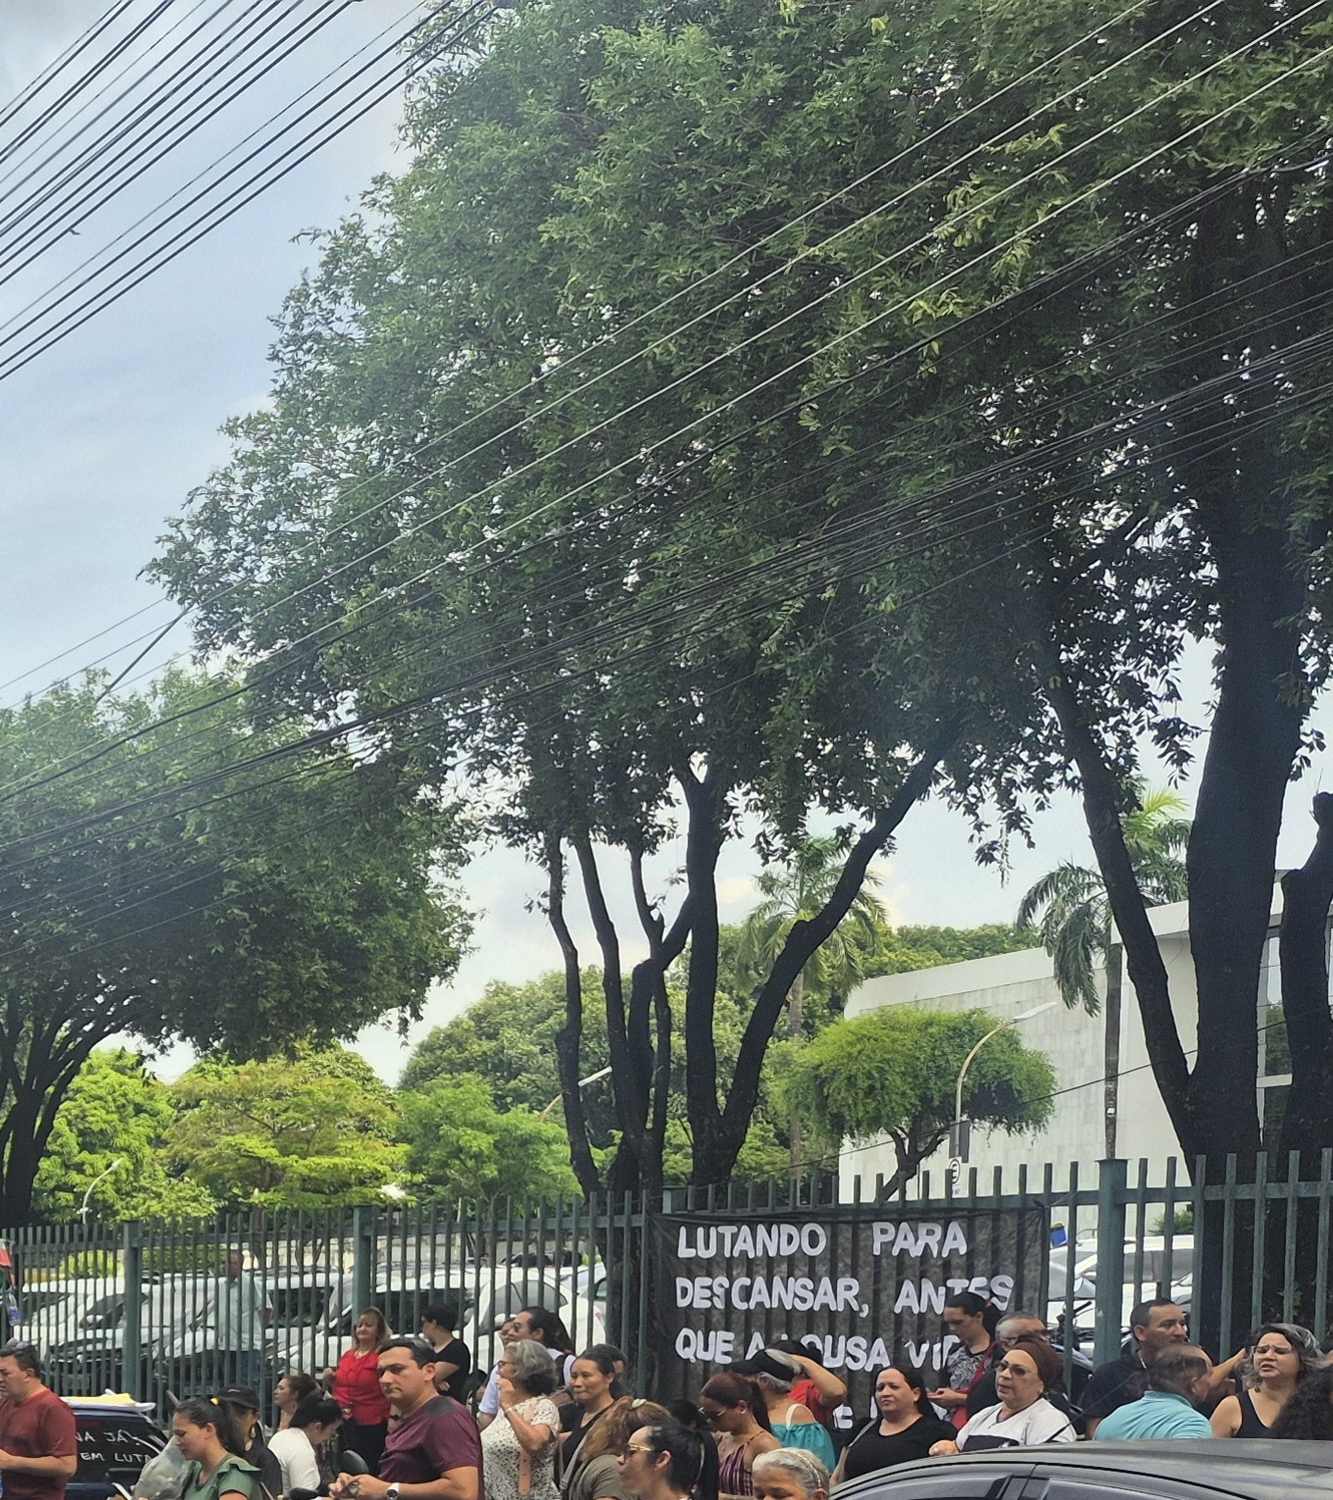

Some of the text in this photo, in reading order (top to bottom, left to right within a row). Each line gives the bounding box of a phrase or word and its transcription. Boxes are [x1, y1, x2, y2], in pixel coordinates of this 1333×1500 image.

[677, 1220, 968, 1260] LUTANDO PARA
[675, 1275, 870, 1318] DESCANSAR,
[675, 1327, 735, 1365] QUE
